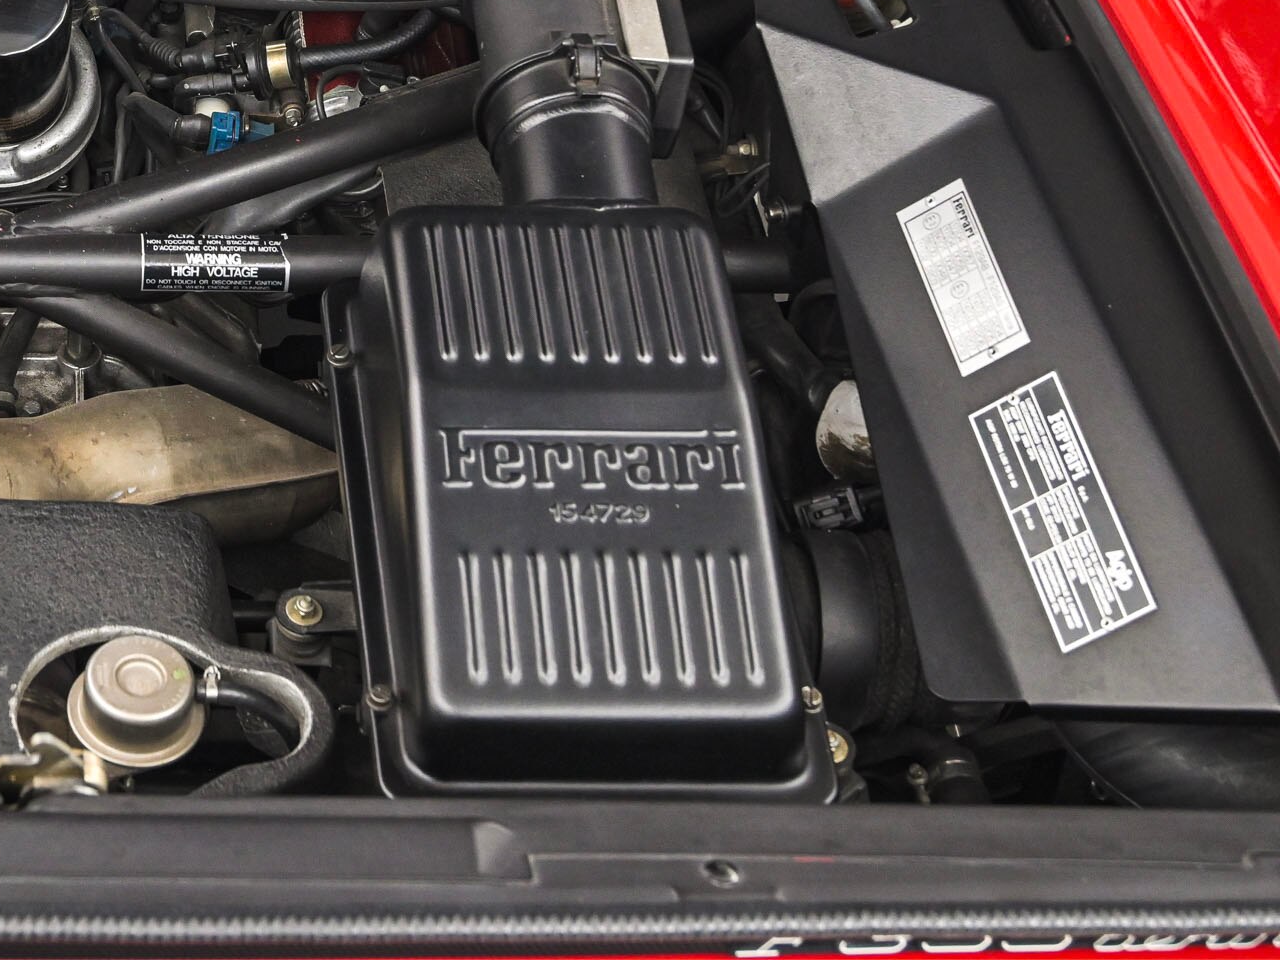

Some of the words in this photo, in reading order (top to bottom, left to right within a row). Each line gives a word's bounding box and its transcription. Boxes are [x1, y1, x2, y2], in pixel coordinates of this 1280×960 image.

[171, 266, 200, 277] HIGH
[206, 266, 259, 278] VOLTAGE
[185, 252, 242, 266] WARNING
[438, 427, 747, 490] Ferrari
[1046, 408, 1091, 482] Ferrari
[1104, 548, 1134, 592] Agip
